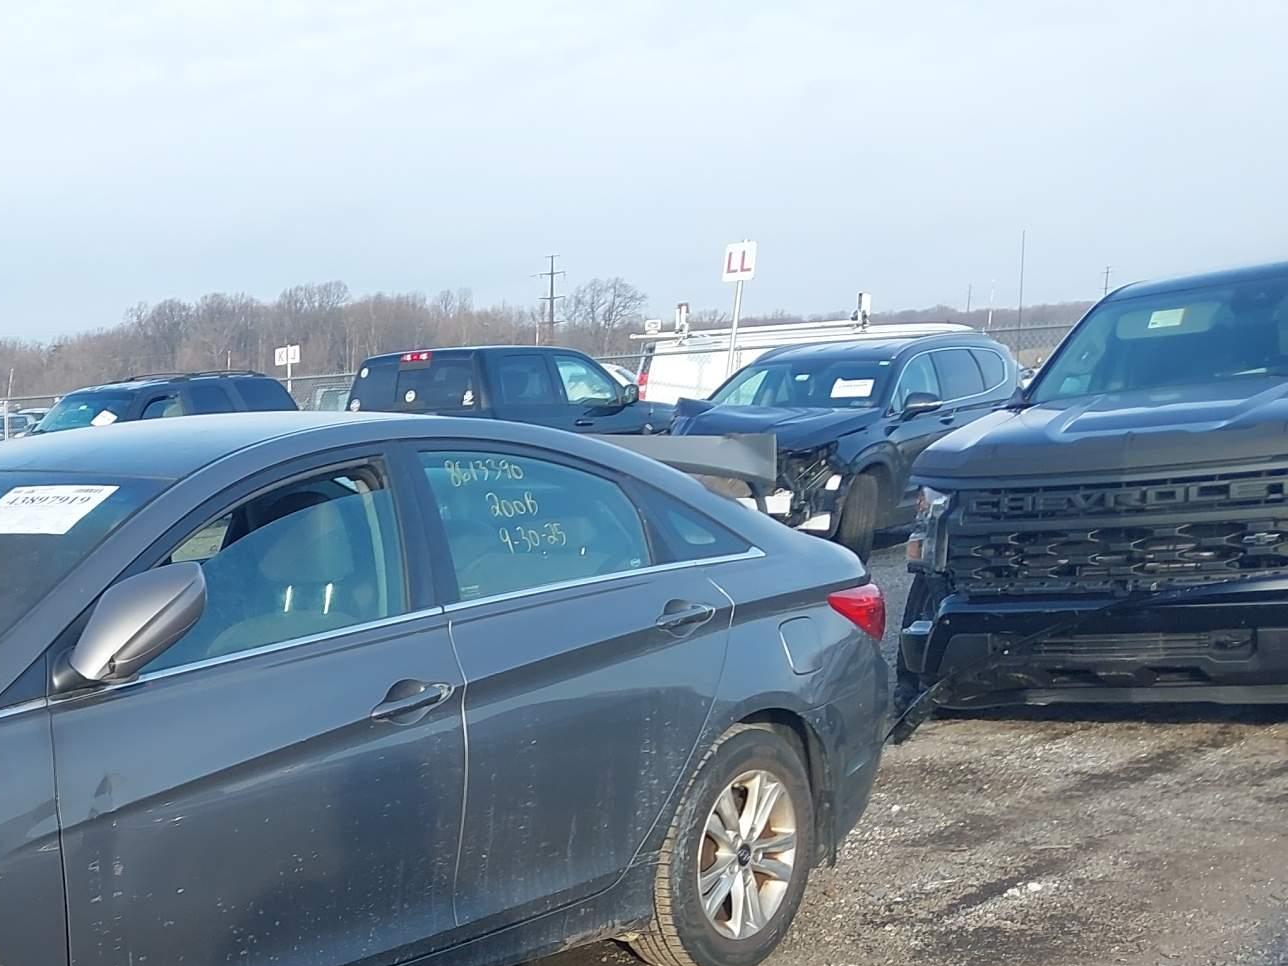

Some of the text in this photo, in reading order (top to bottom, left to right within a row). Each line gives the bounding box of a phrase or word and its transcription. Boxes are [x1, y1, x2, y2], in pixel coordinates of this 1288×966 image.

[726, 250, 753, 274] LL
[444, 458, 525, 487] 8613390
[6, 495, 92, 506] 43897919
[484, 491, 540, 518] 200B
[498, 522, 568, 553] 9-30-25
